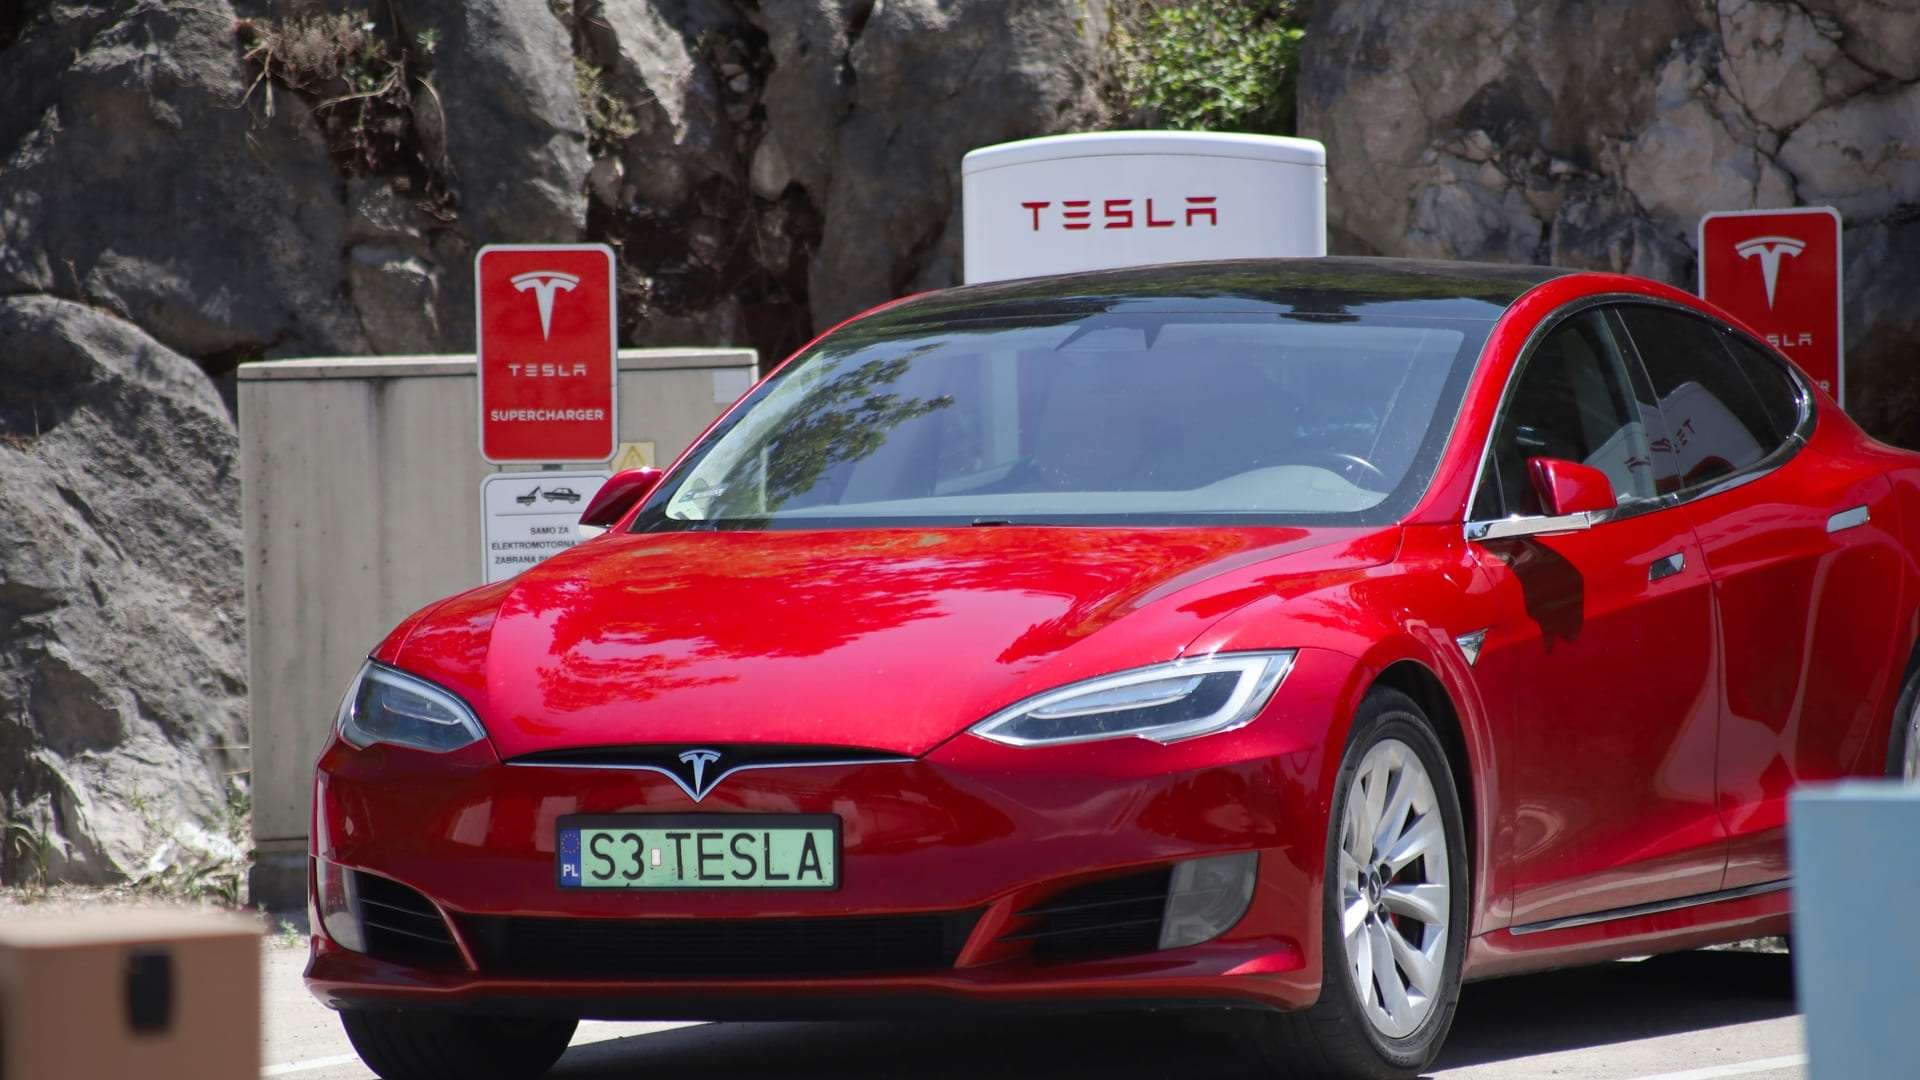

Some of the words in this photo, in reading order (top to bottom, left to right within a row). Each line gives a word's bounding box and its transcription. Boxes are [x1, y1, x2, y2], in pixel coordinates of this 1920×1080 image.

[1021, 196, 1218, 231] TESLA
[1765, 332, 1813, 347] SLA
[508, 363, 587, 377] TESLA
[490, 408, 605, 422] SUPERCHARGER
[530, 526, 557, 535] SAMO
[558, 526, 569, 535] ZA
[495, 555, 537, 565] ZABRANA
[589, 831, 645, 881] S3
[665, 831, 824, 881] TESLA
[562, 863, 579, 877] PL
